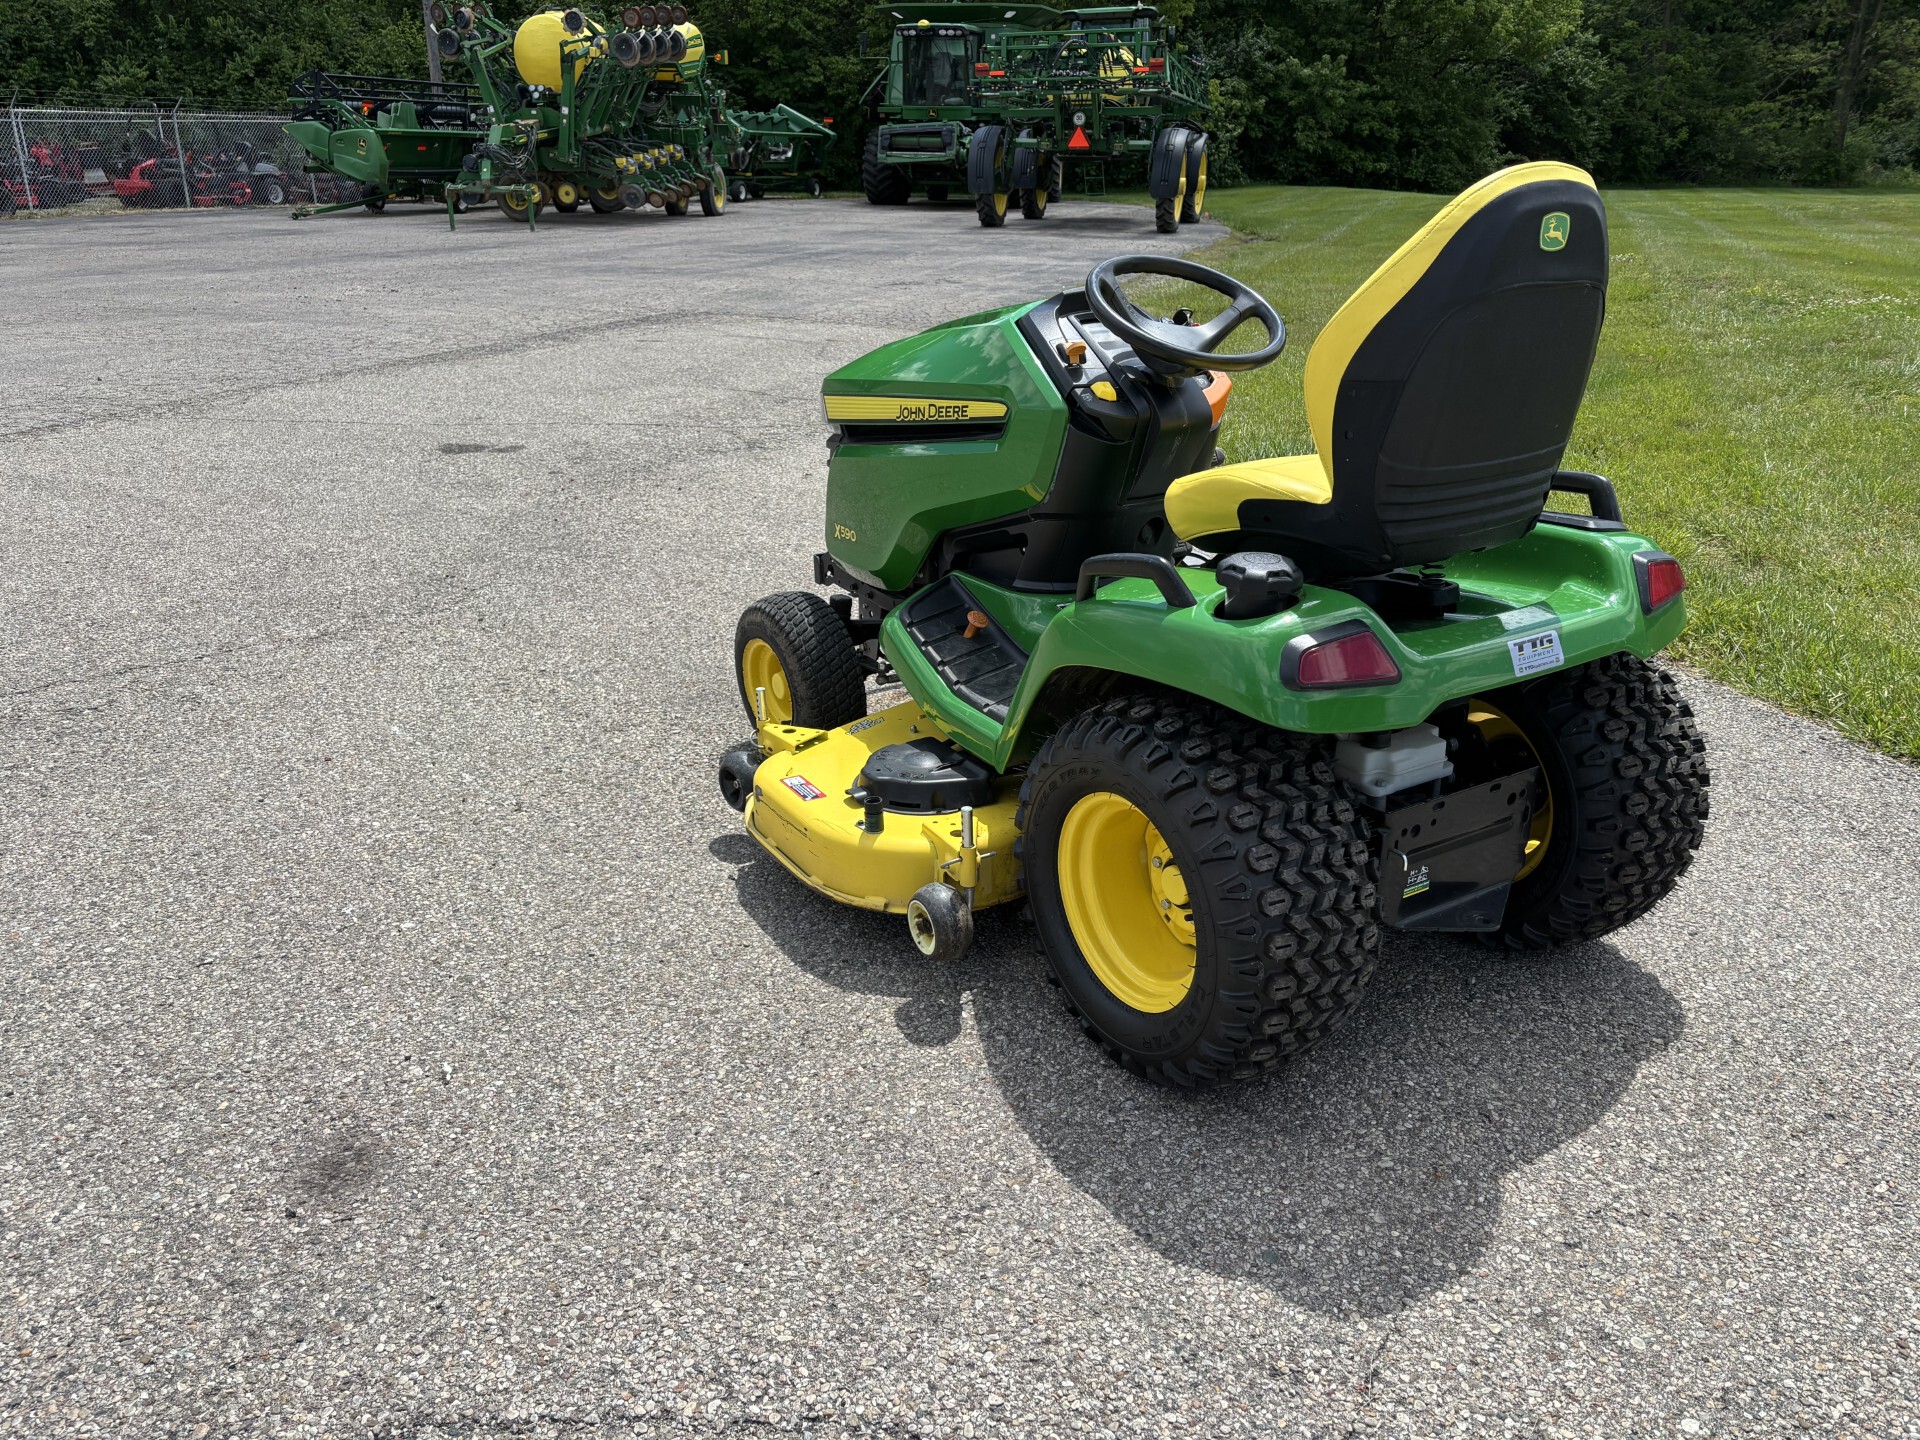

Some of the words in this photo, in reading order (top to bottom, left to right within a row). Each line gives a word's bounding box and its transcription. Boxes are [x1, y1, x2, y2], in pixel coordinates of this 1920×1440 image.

[896, 404, 926, 420] JOHN
[928, 403, 969, 419] DEERE
[834, 522, 857, 542] X590
[1513, 633, 1553, 656] TTG
[1518, 648, 1555, 663] EQUIPMENT
[1059, 767, 1103, 783] TRAX
